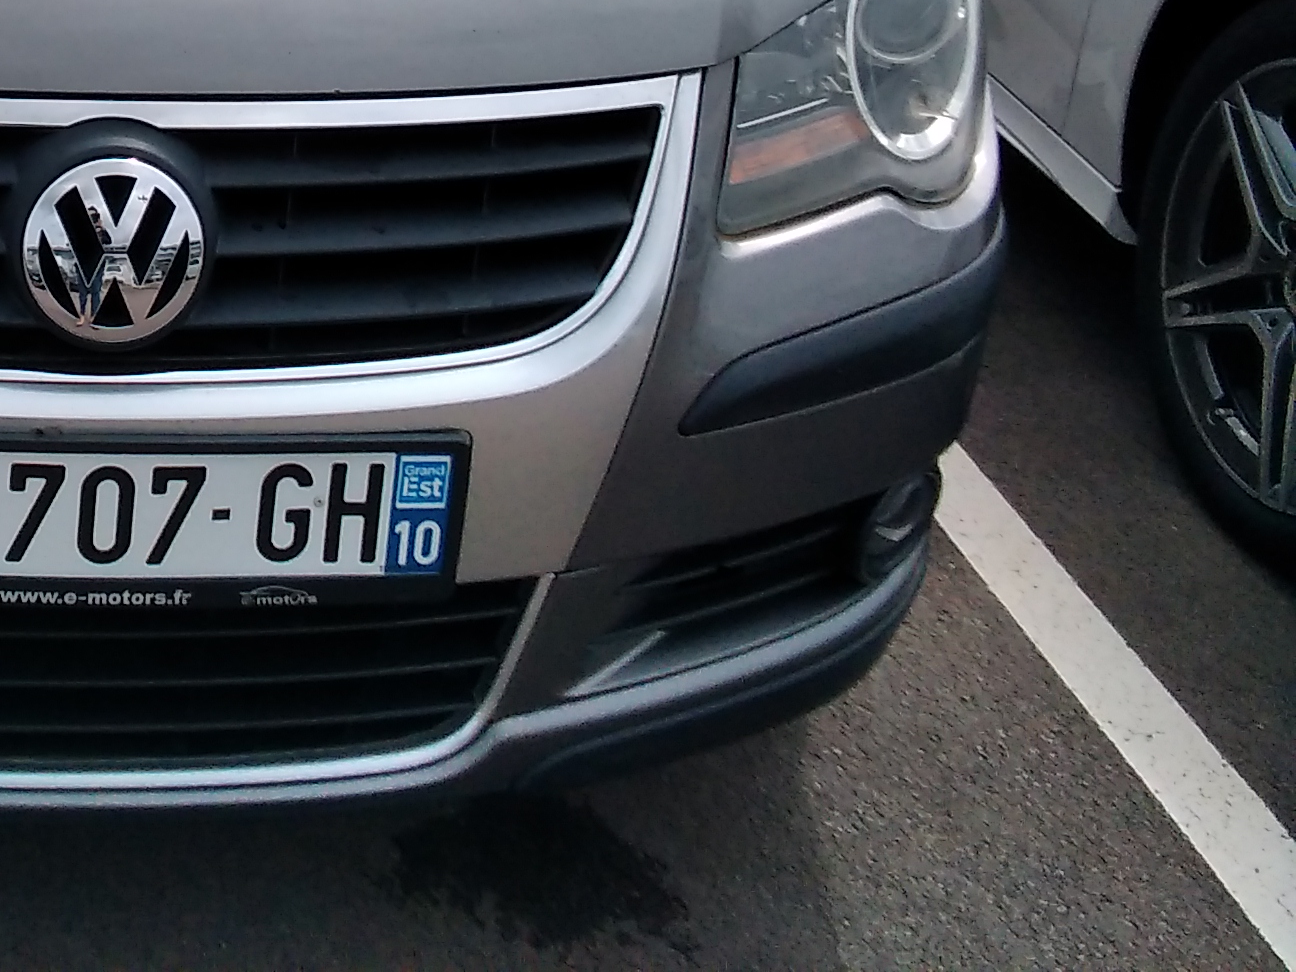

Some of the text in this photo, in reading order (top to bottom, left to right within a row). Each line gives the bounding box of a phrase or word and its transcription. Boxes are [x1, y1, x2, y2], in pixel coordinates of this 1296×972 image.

[404, 465, 445, 476] Grand
[402, 477, 443, 497] Est
[394, 520, 441, 566] 10
[0, 589, 192, 606] www.e-motors.fr
